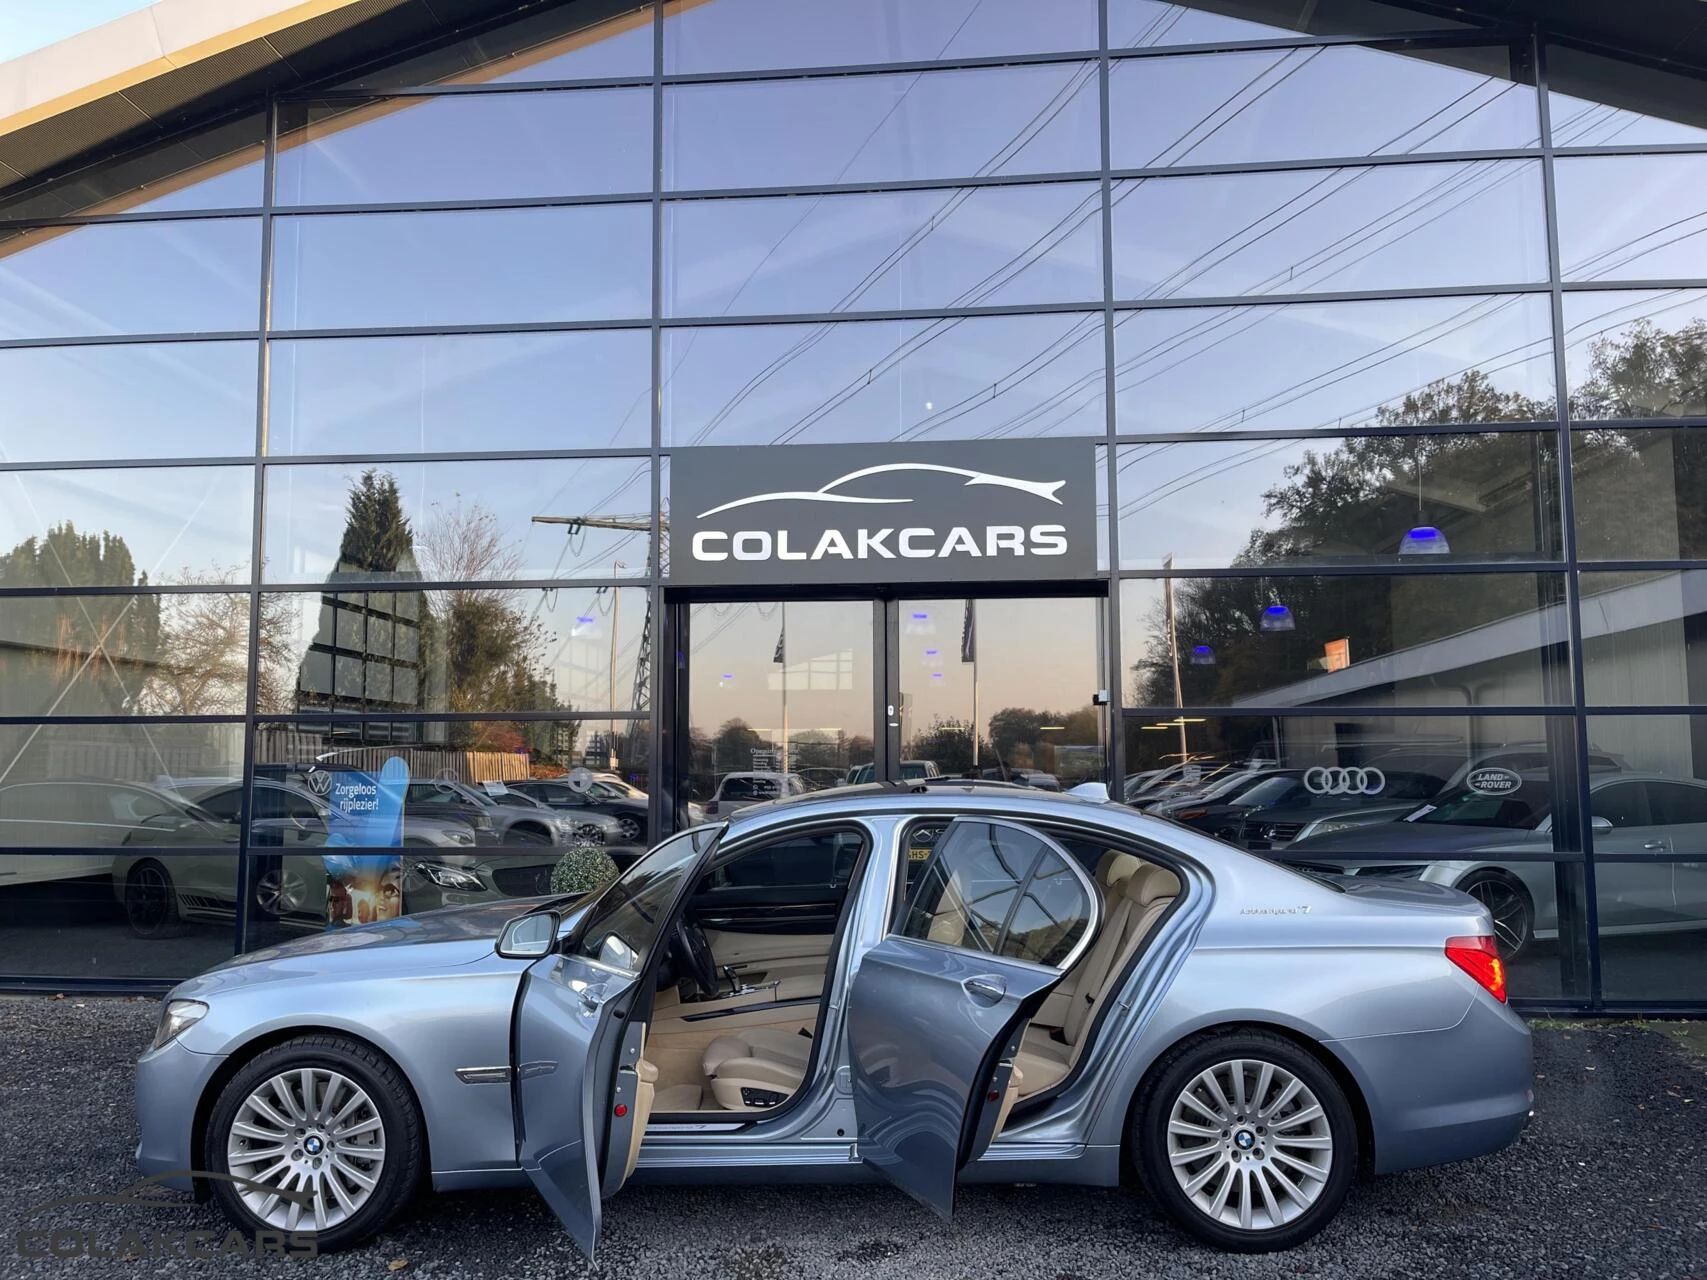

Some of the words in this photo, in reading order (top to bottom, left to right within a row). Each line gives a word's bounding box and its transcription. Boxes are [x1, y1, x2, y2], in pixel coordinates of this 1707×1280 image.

[692, 524, 1068, 561] COLAKCARS
[335, 783, 377, 798] Zorgeloos
[340, 798, 379, 813] rijplezier!
